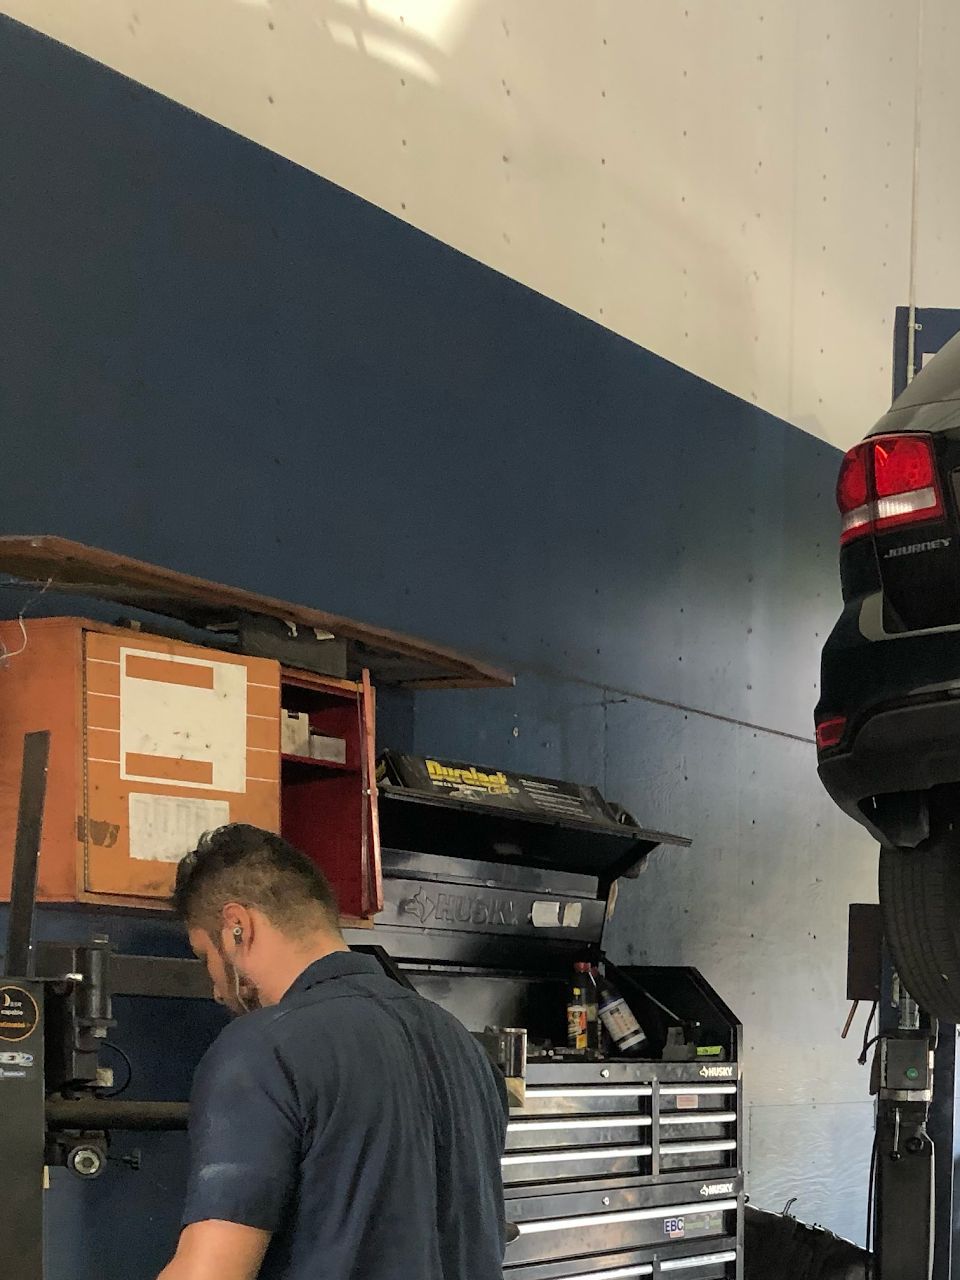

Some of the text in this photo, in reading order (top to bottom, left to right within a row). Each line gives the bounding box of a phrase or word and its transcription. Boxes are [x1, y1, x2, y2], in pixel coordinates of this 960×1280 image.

[883, 537, 953, 559] JOURNEY
[425, 759, 508, 787] Duralast
[708, 1066, 733, 1077] HUSKY
[708, 1183, 734, 1195] HUSKY
[665, 1218, 684, 1233] EBC
